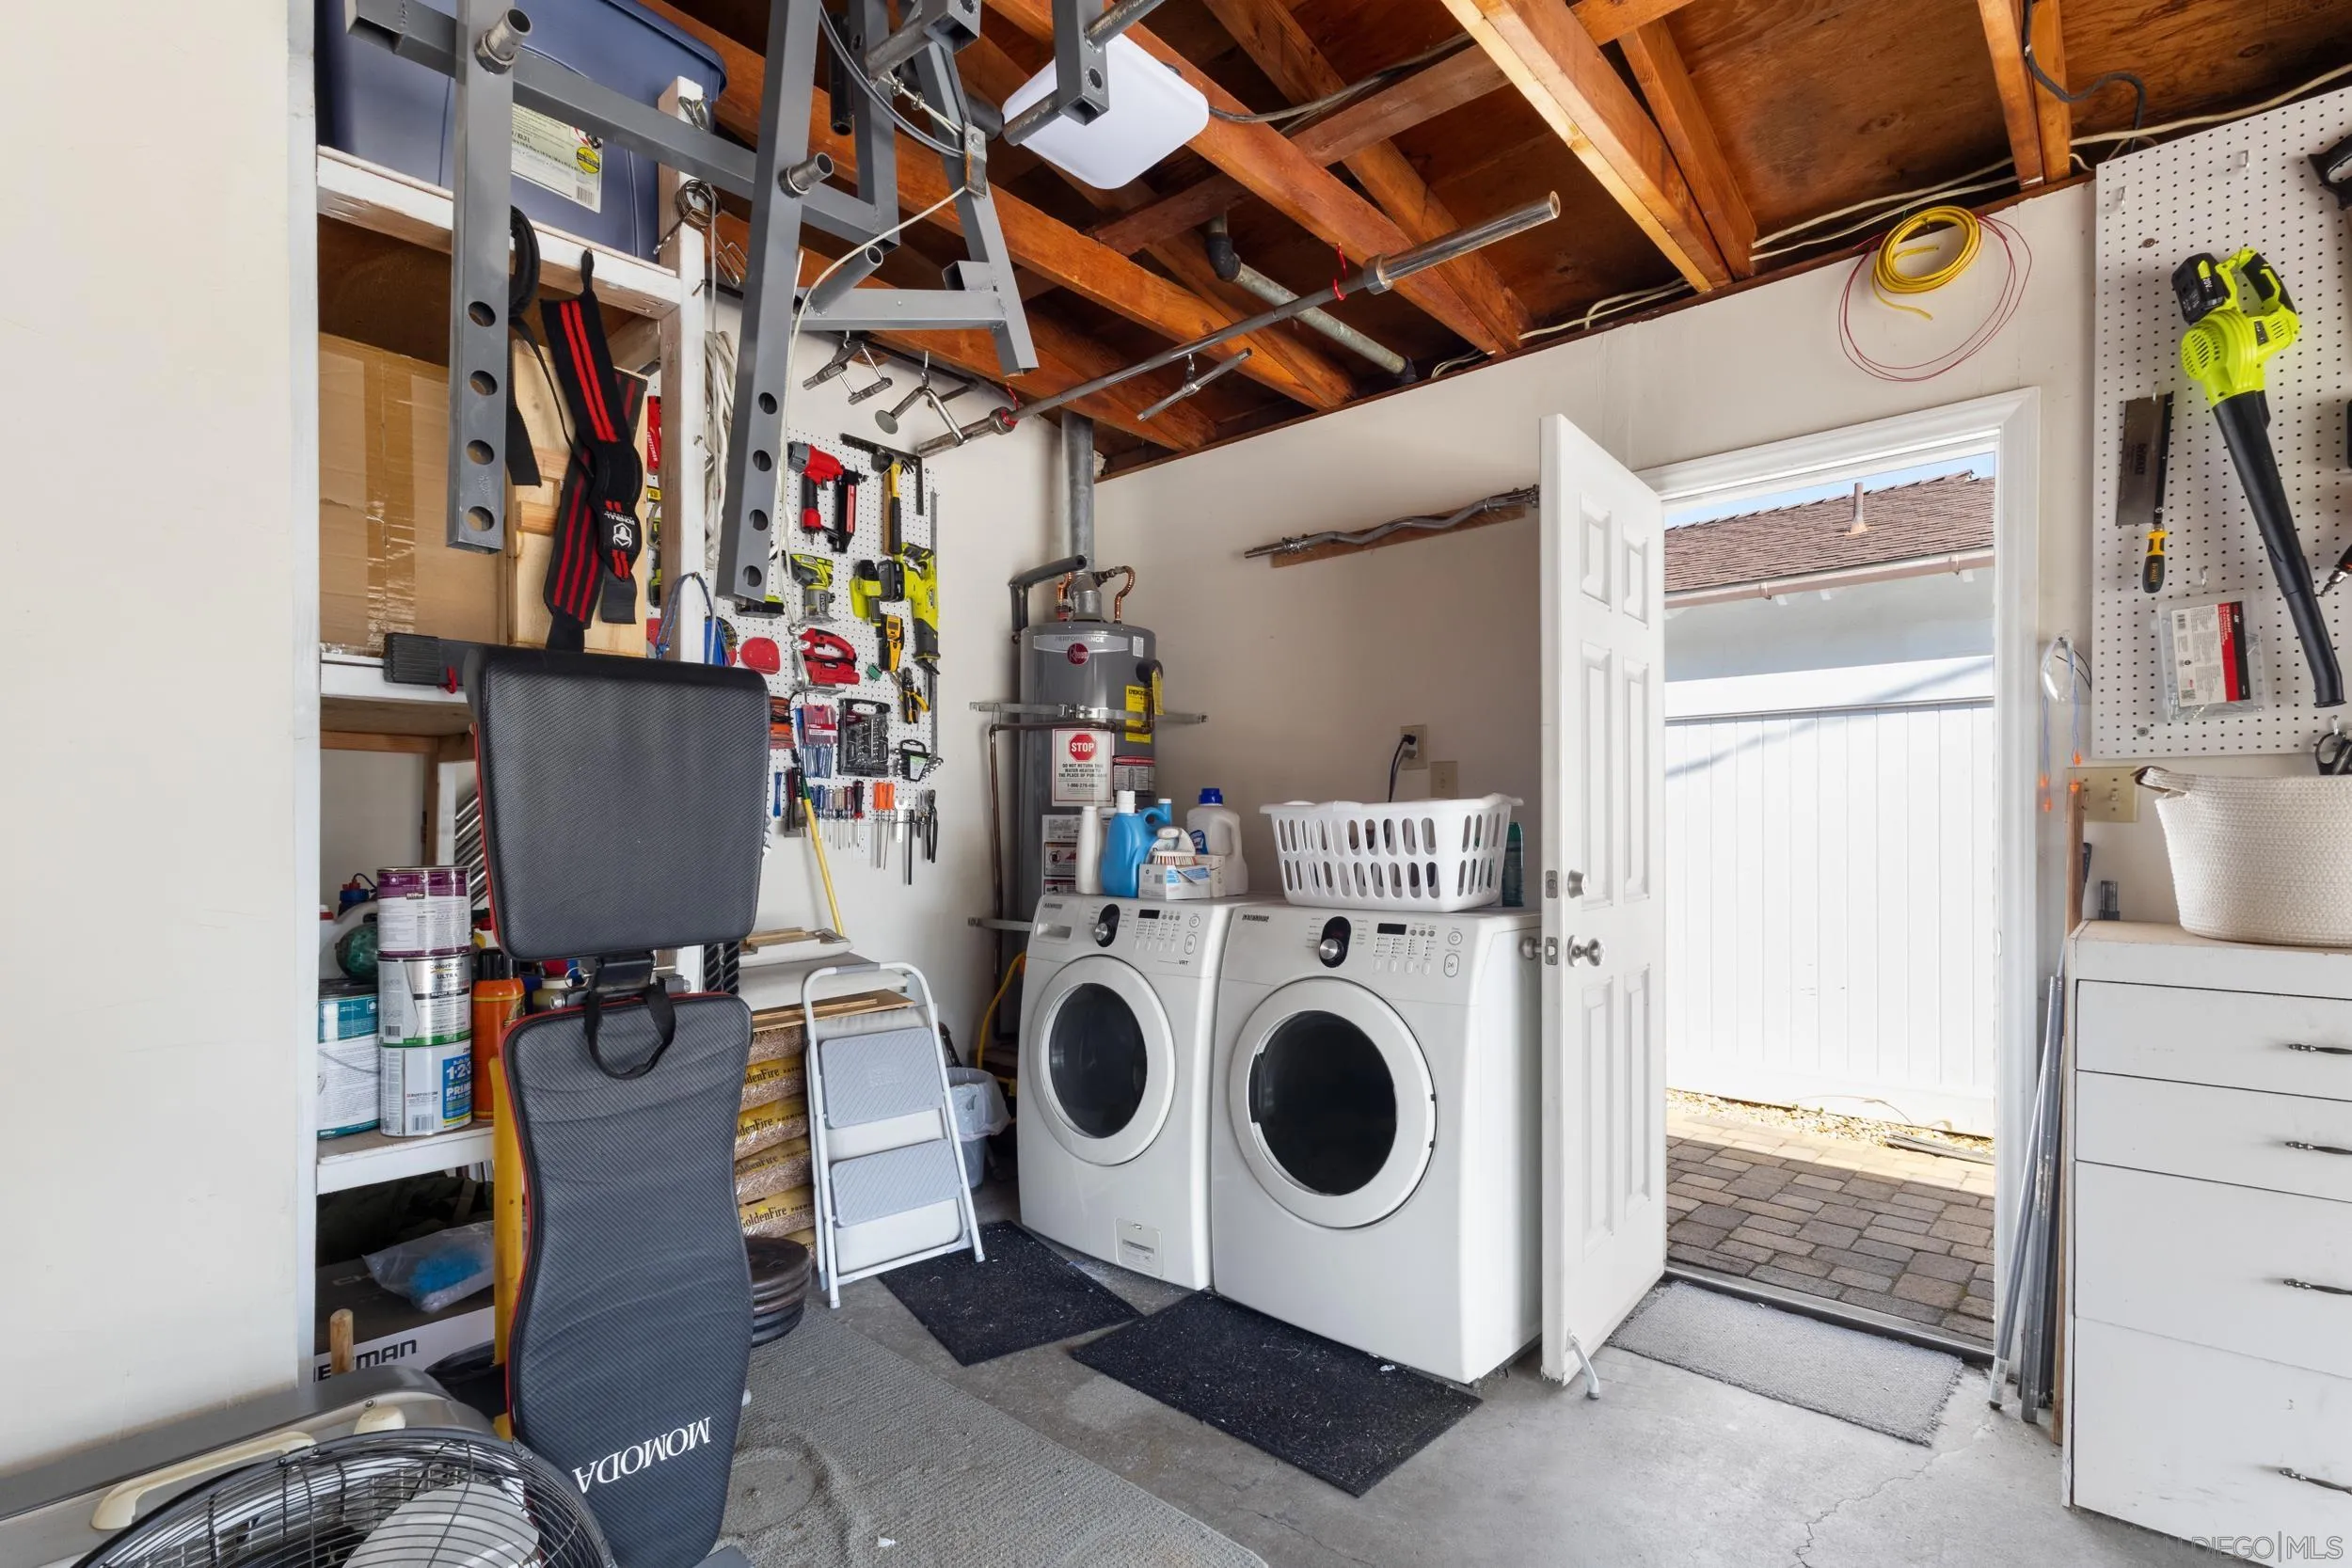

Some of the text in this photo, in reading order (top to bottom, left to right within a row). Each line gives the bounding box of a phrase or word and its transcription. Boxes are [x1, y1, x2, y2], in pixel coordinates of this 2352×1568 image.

[1071, 742, 1095, 752] STOP
[446, 1083, 471, 1098] PRIM
[572, 1417, 711, 1494] MOMODA
